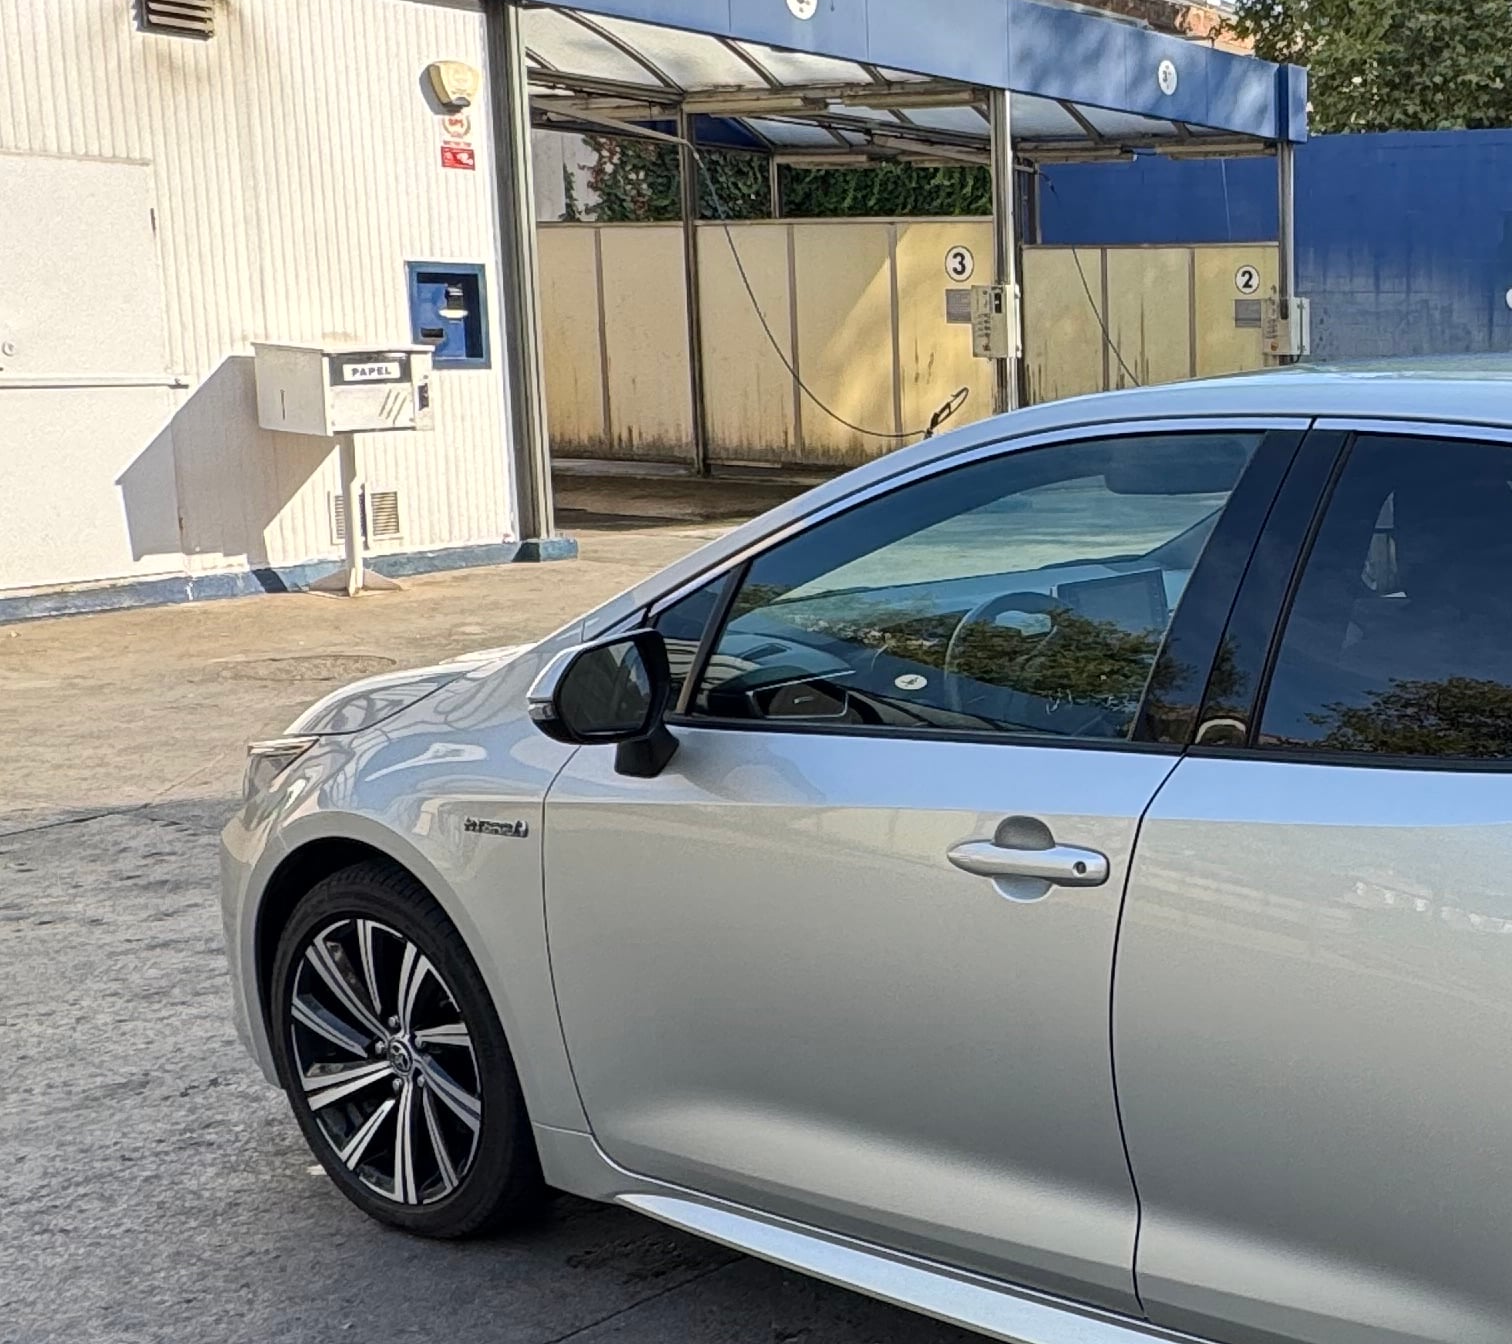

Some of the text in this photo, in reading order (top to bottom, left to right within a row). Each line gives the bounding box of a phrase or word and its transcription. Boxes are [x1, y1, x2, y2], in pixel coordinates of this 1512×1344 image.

[952, 252, 966, 276] 3
[1240, 270, 1254, 289] 2
[351, 366, 392, 377] PAPEL
